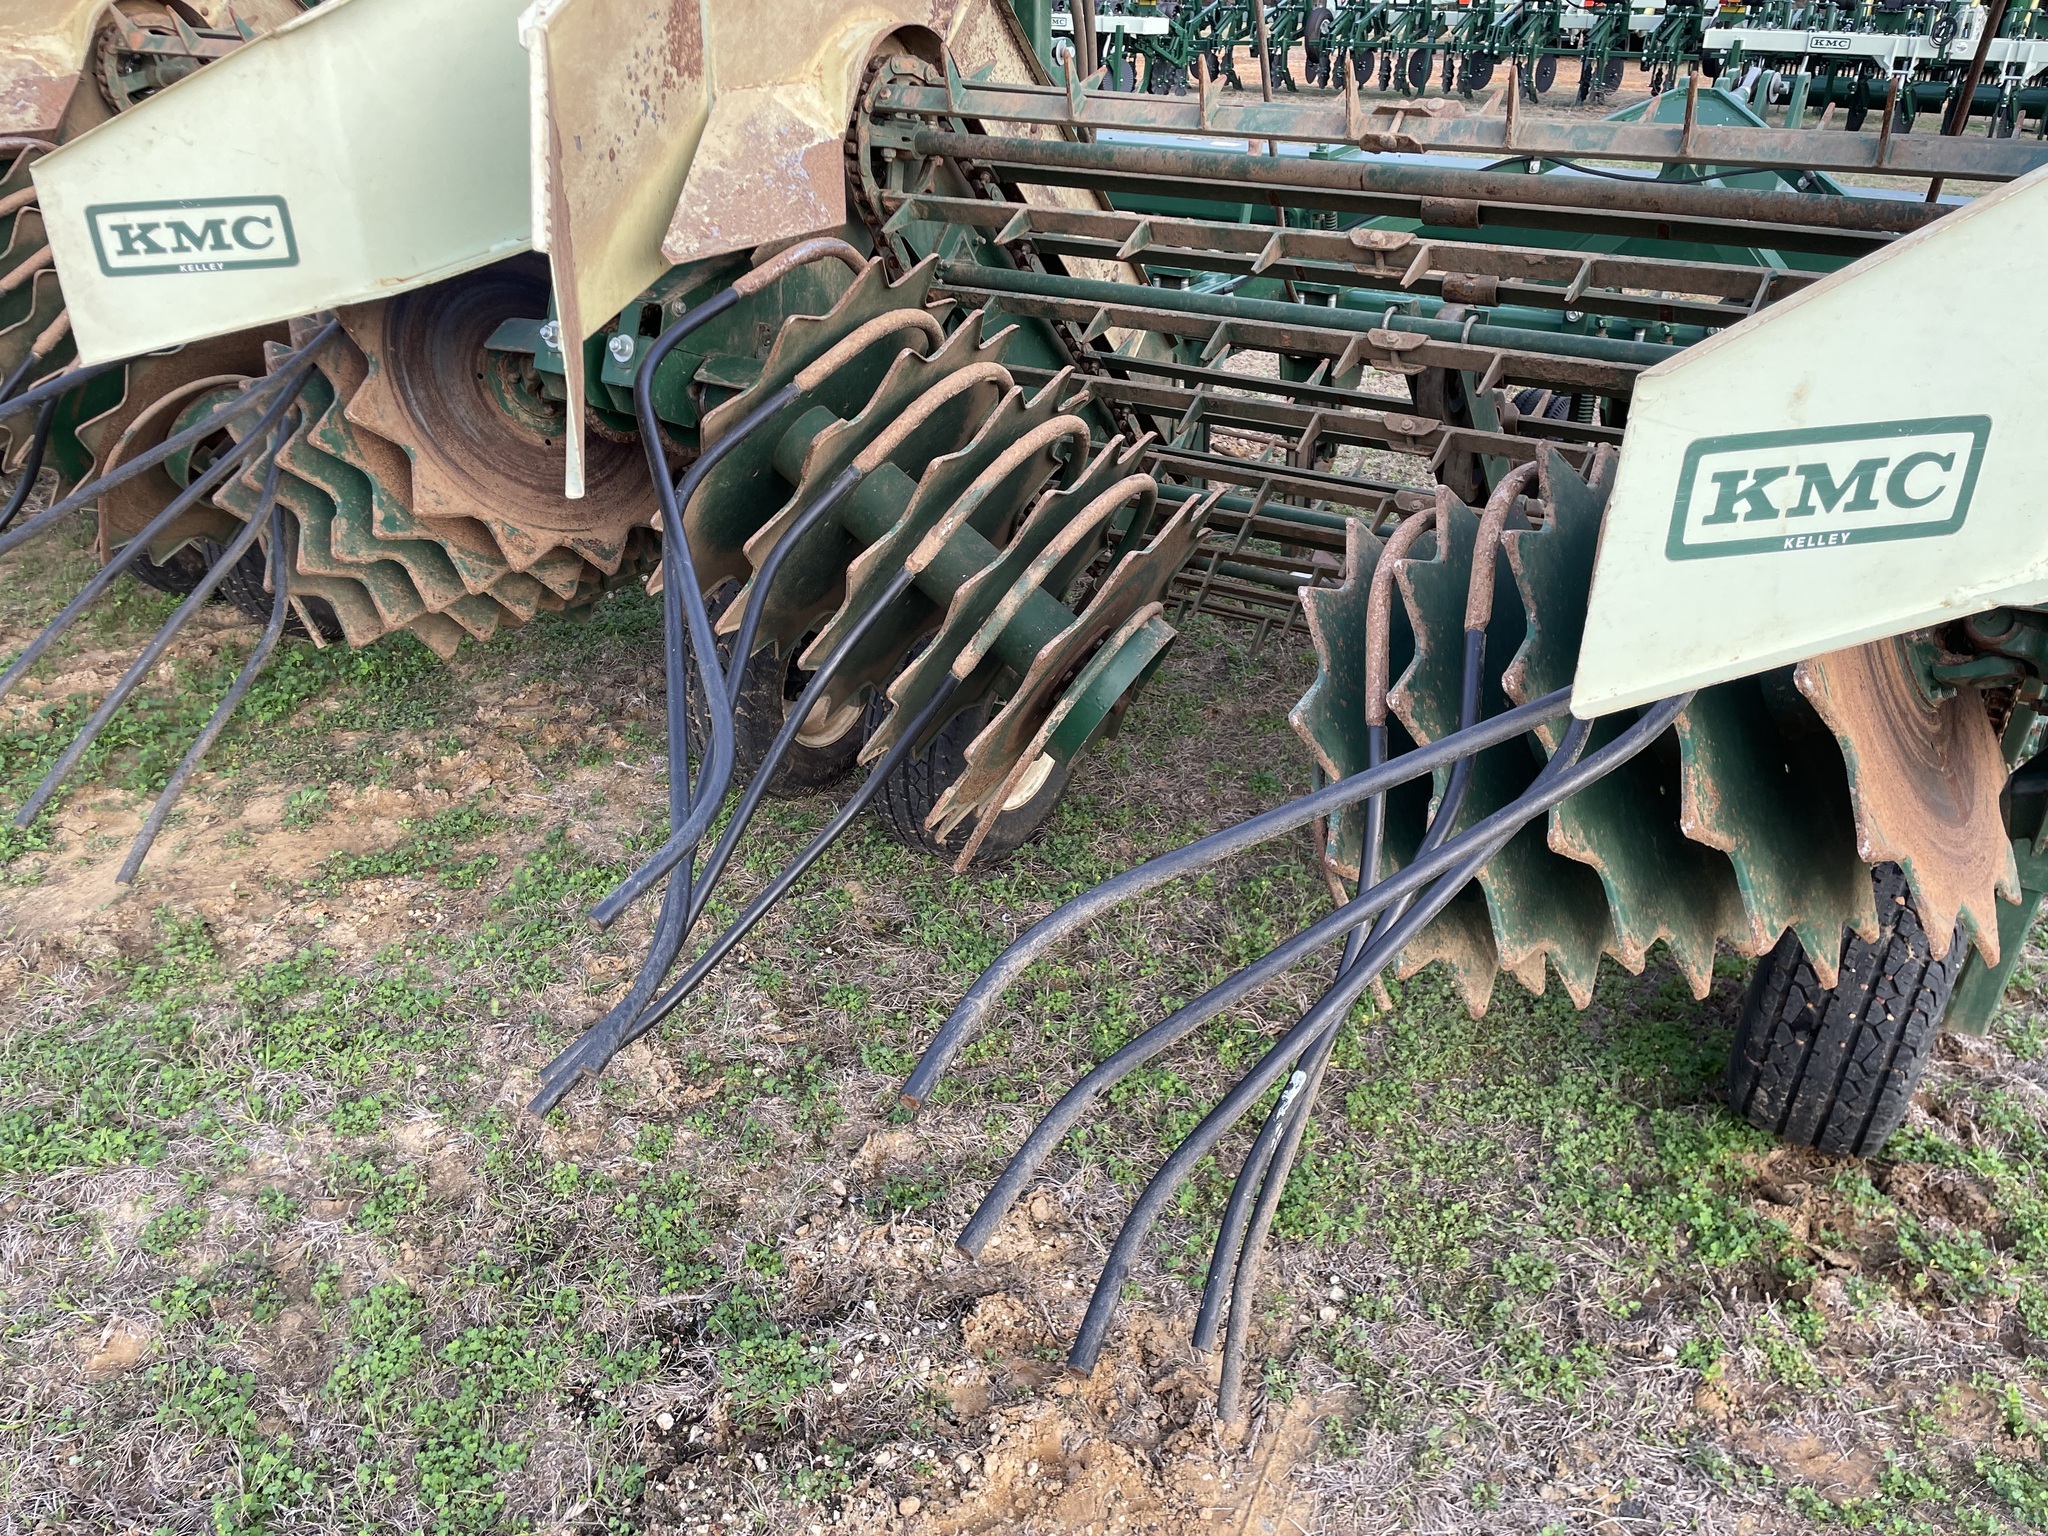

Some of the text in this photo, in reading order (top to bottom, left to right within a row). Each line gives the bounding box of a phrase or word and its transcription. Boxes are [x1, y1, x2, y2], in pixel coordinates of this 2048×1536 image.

[1814, 39, 1848, 47] KMC
[109, 215, 275, 256] KMC
[179, 262, 225, 273] KELLEY
[1701, 451, 1957, 526] KMC
[1783, 532, 1852, 550] KELLEY
